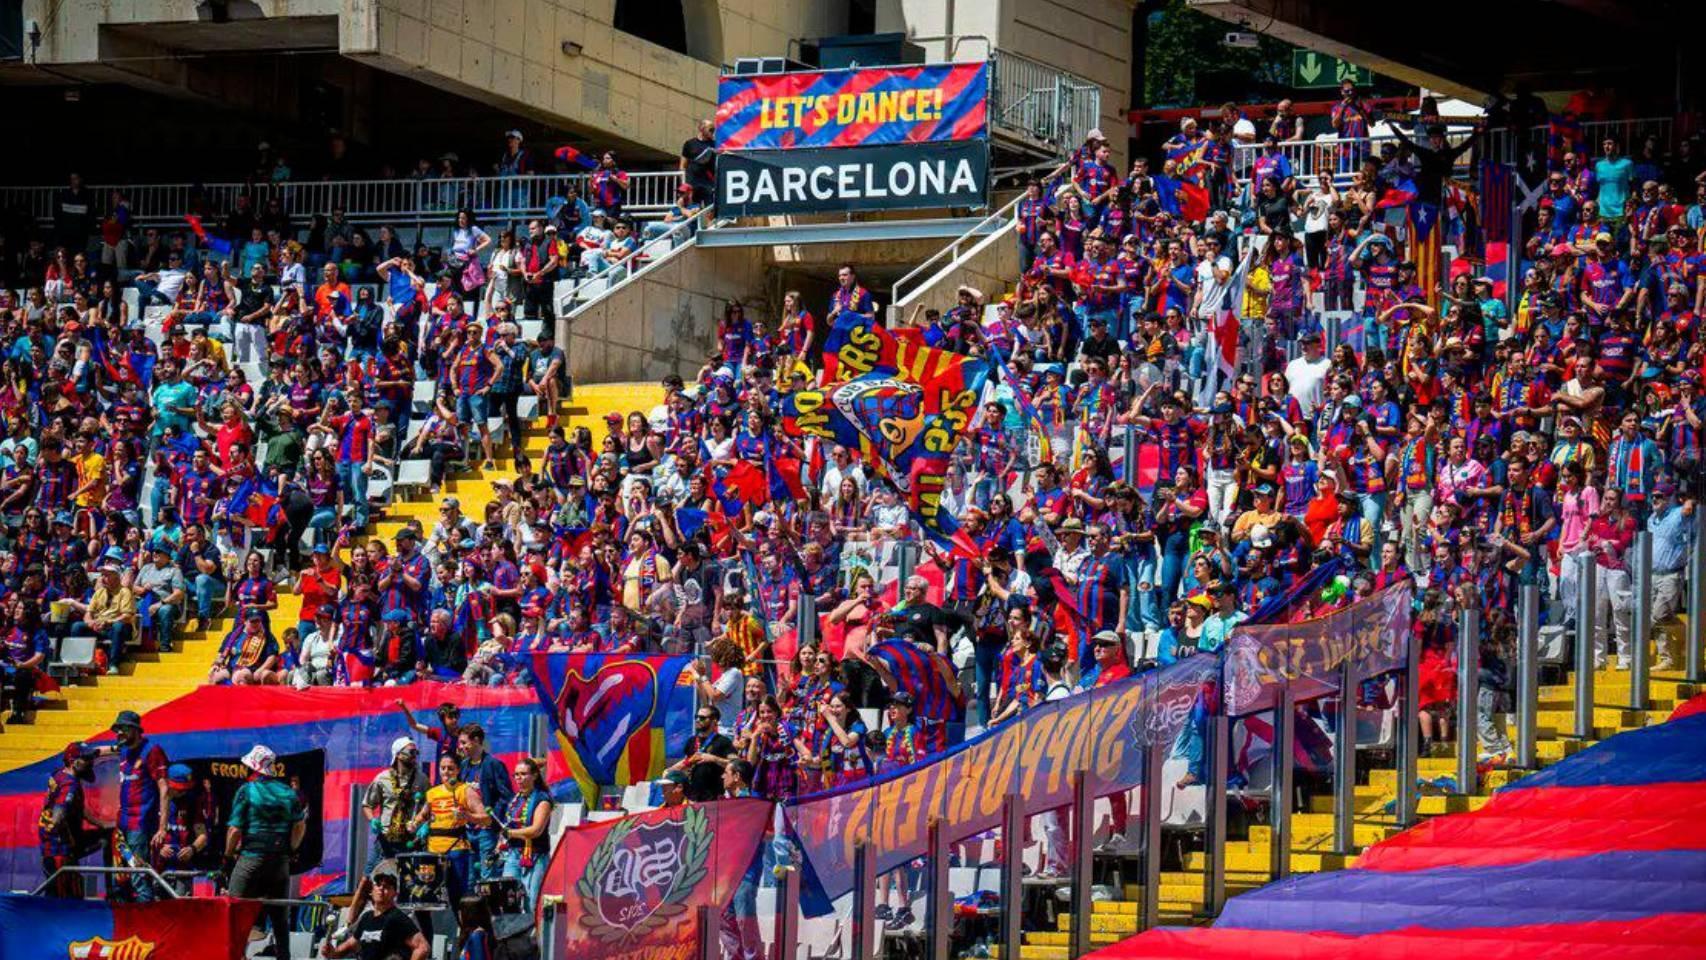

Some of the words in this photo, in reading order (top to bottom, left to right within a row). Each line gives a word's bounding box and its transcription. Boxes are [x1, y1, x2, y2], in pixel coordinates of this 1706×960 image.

[760, 95, 829, 129] LET'S
[837, 88, 943, 126] DANCE!
[726, 158, 978, 205] BARCELONA
[211, 761, 248, 778] FRON
